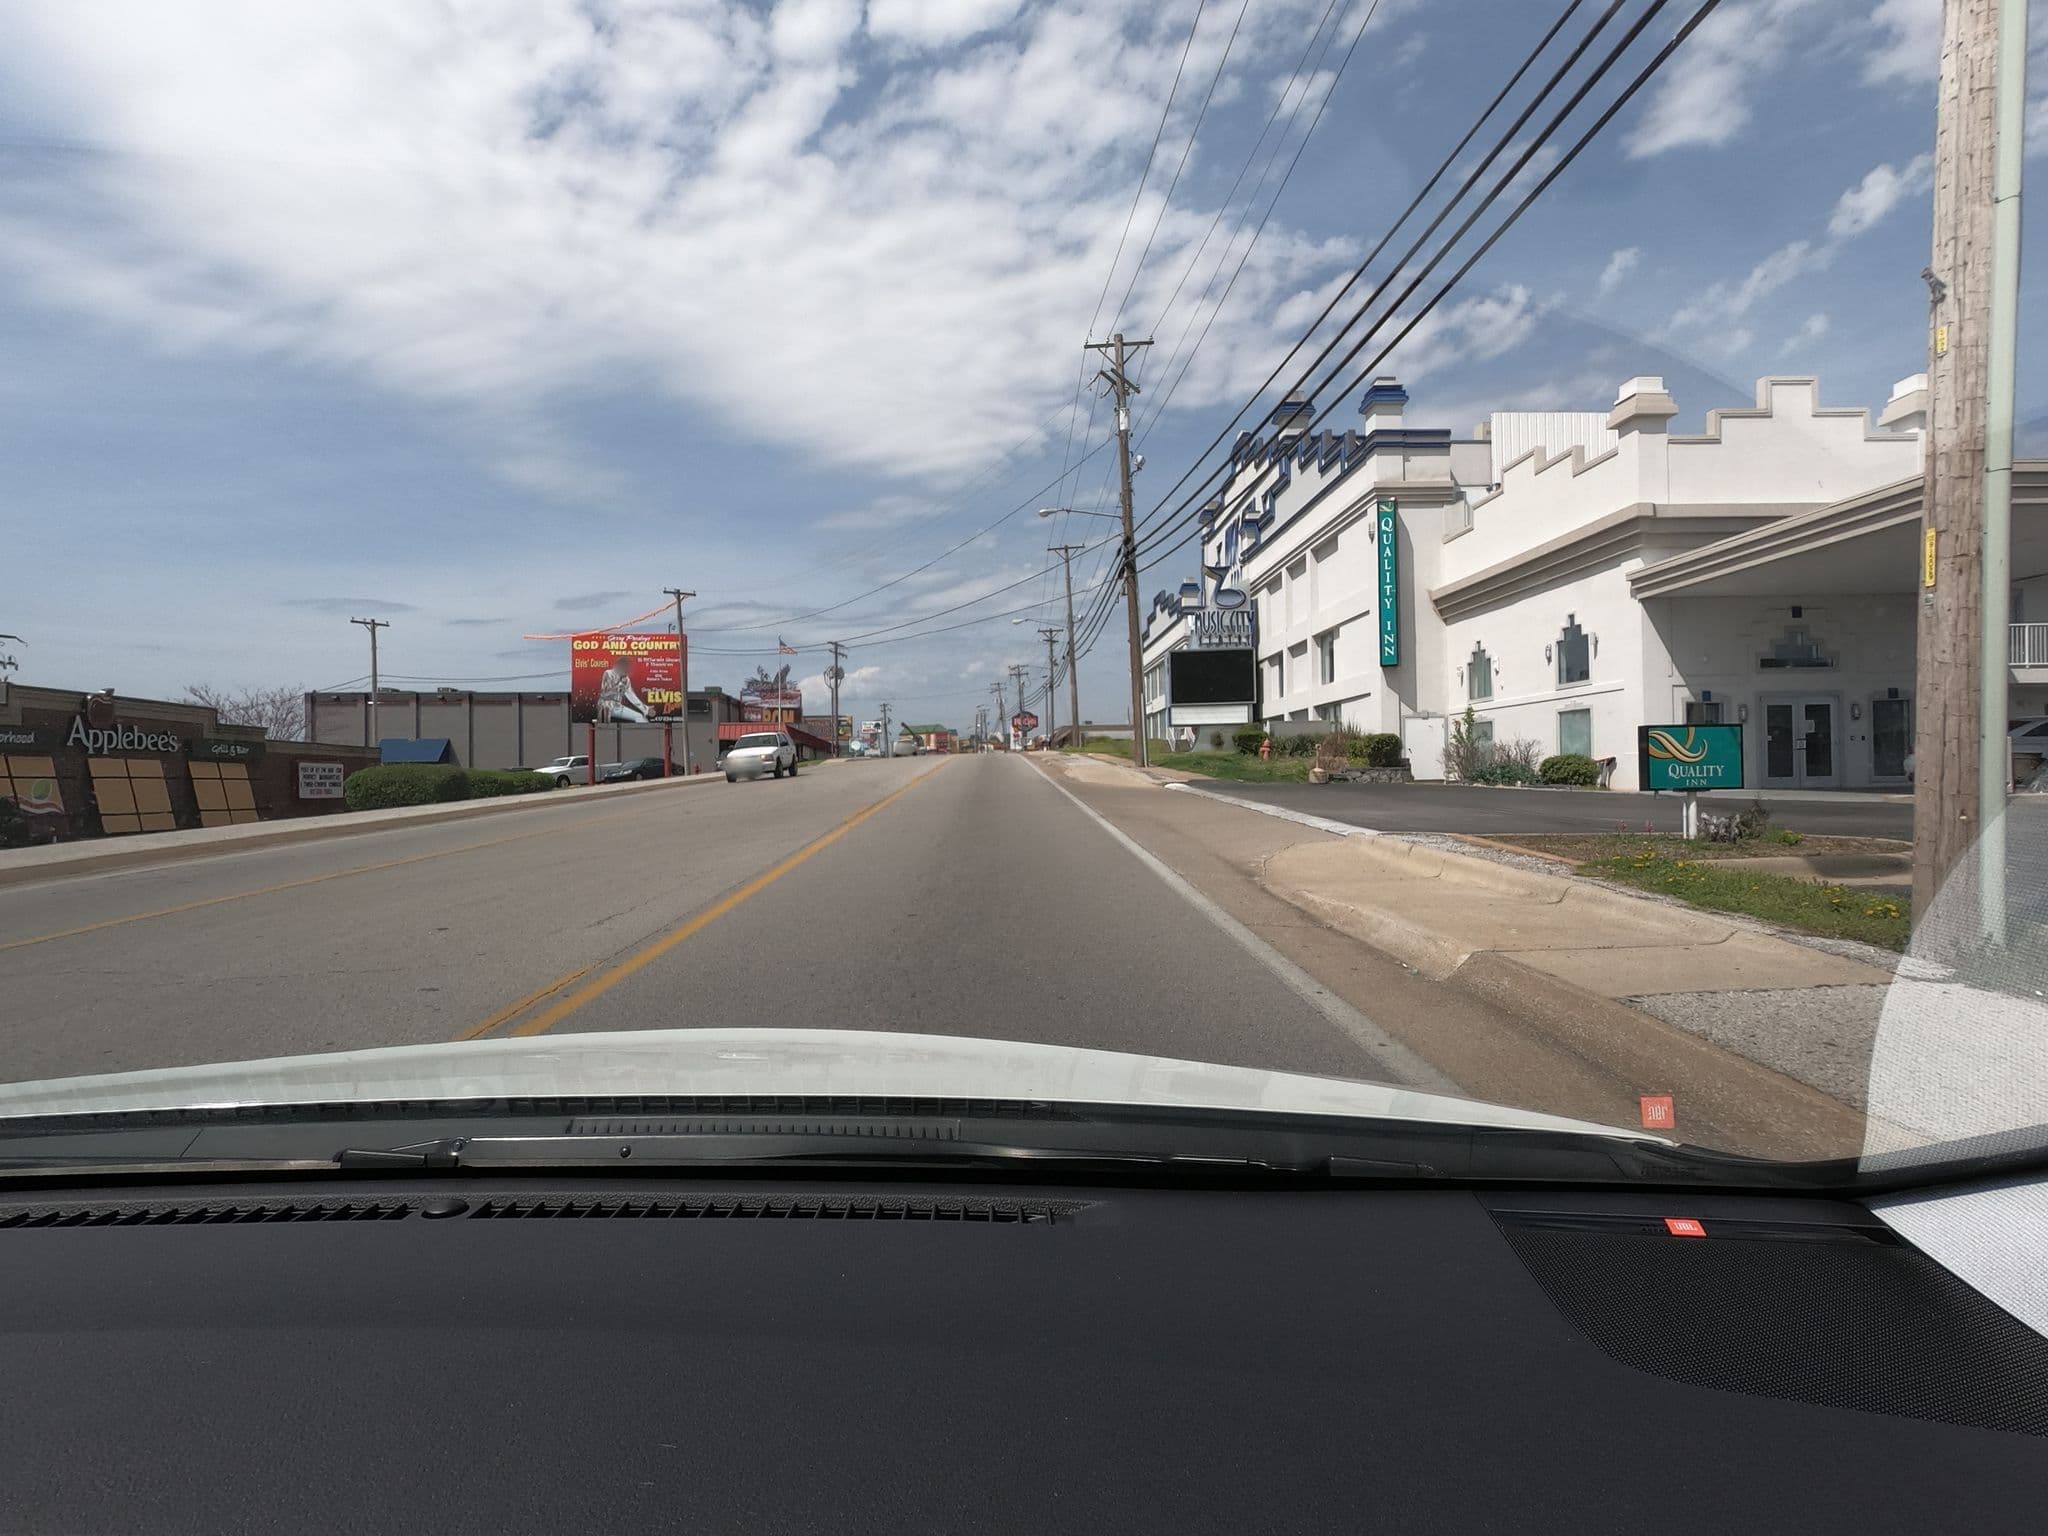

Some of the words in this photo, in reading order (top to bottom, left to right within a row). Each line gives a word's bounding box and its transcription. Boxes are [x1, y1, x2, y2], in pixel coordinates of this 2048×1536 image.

[1381, 517, 1394, 610] QUALITY
[1194, 610, 1226, 634] MUSIC
[1230, 610, 1255, 634] CITY
[573, 641, 599, 650] GOD
[602, 641, 628, 650] AND
[1384, 621, 1396, 657] INN
[591, 658, 609, 668] Cousin
[648, 691, 682, 703] ELVIS
[66, 714, 179, 755] Applebee's
[1668, 764, 1725, 779] QUALITY
